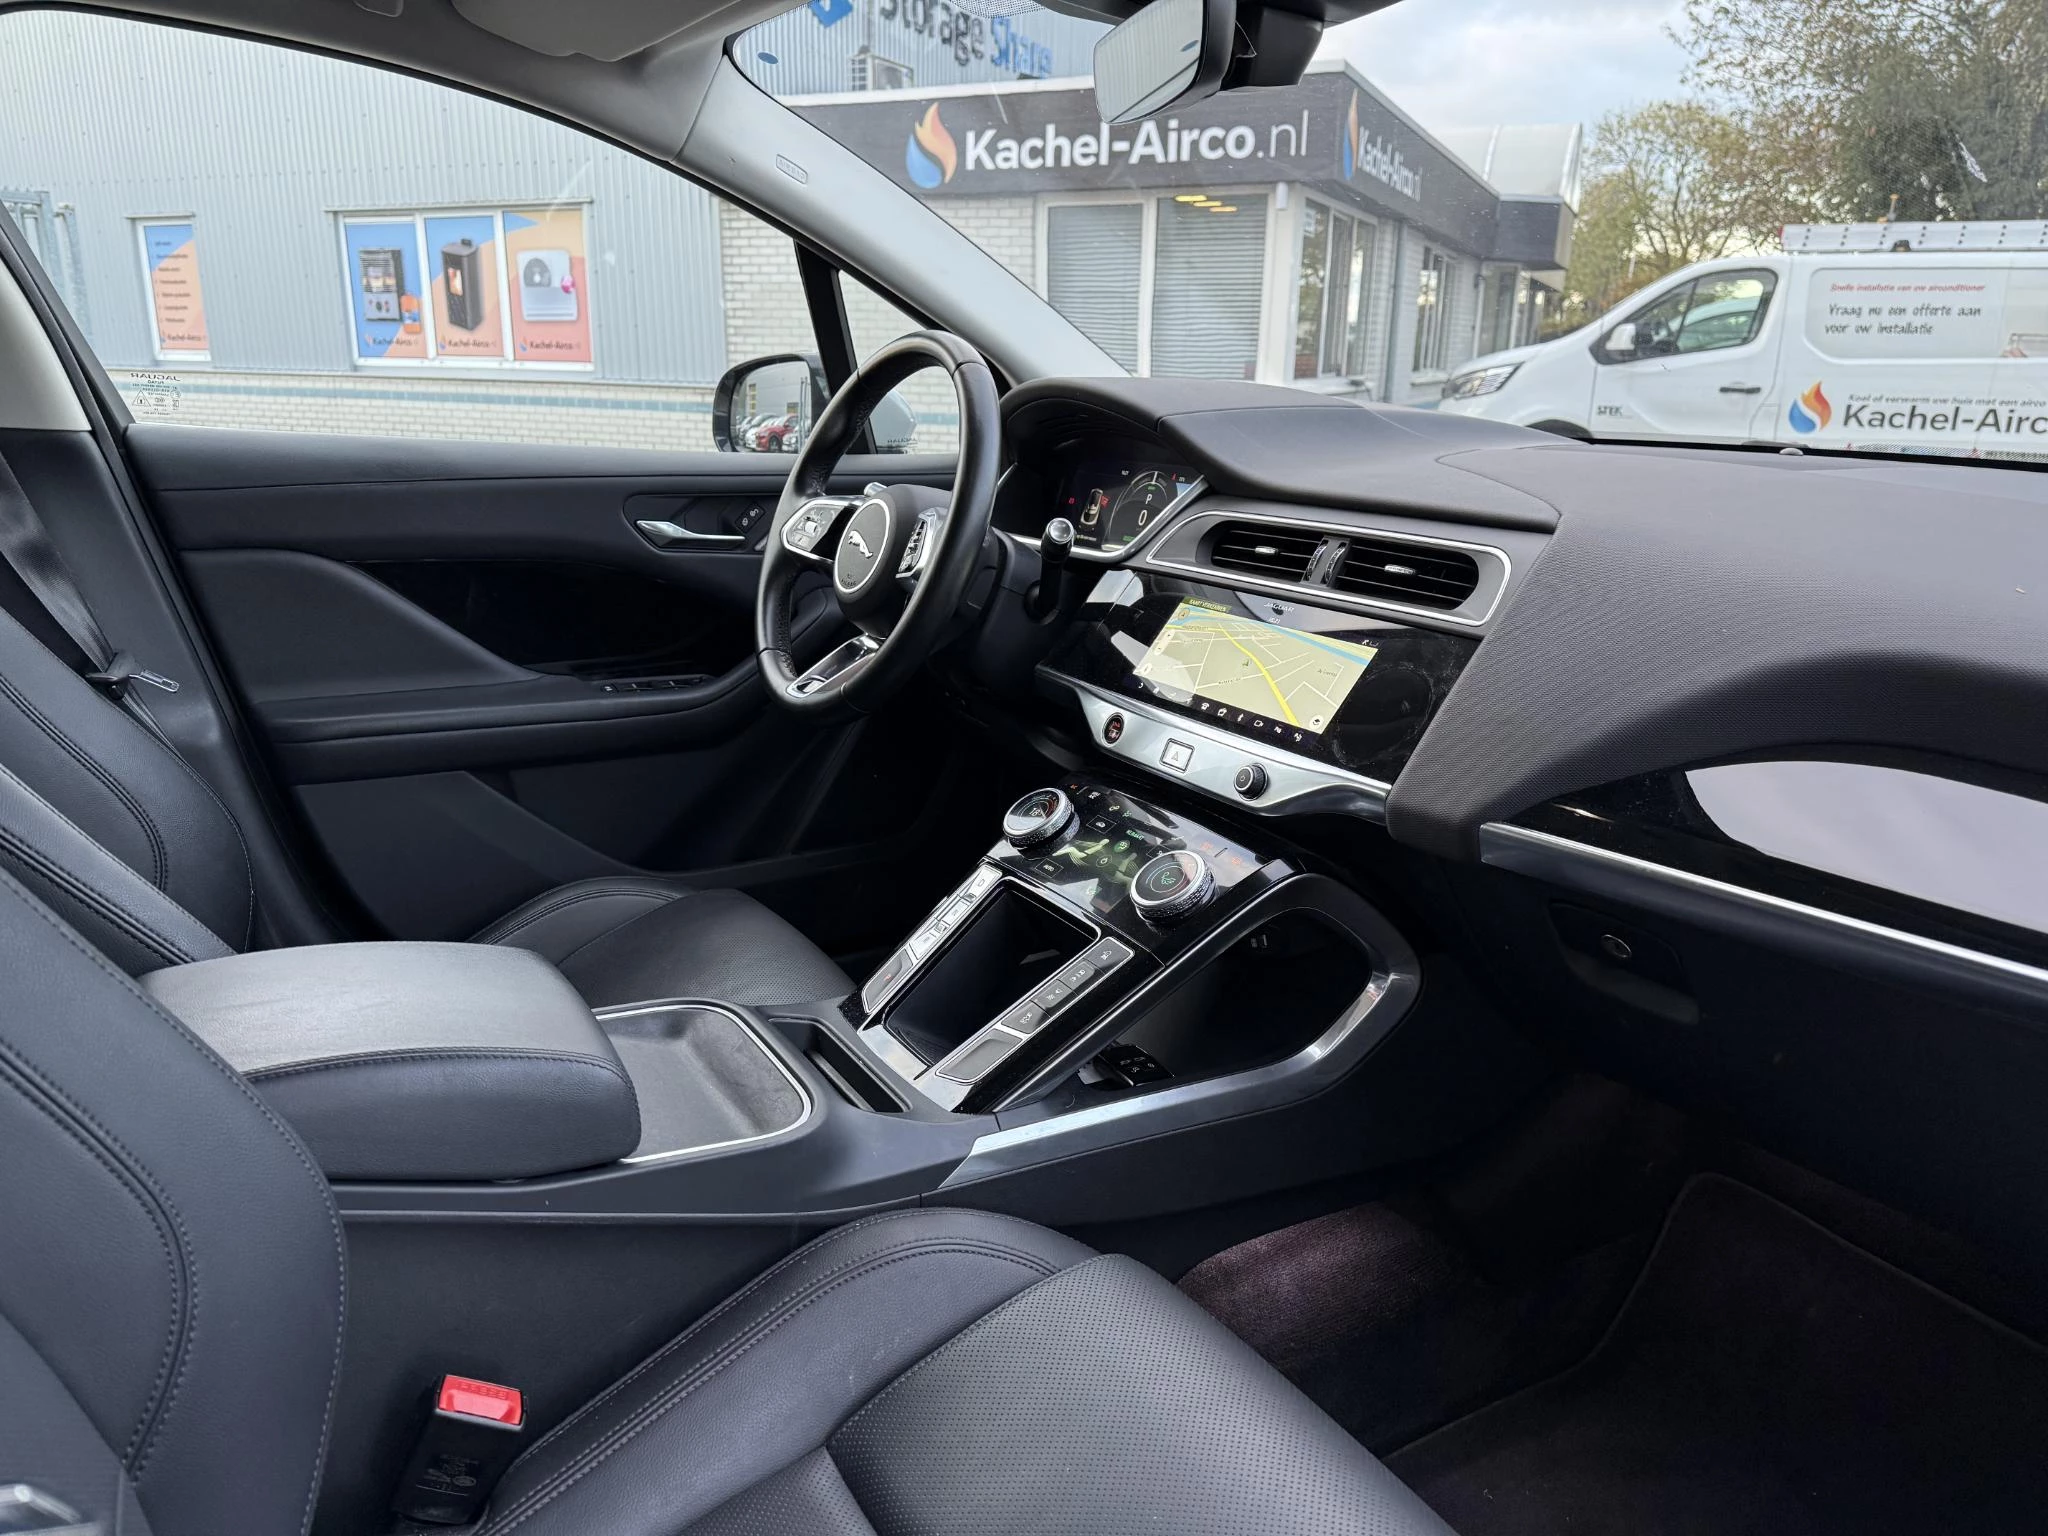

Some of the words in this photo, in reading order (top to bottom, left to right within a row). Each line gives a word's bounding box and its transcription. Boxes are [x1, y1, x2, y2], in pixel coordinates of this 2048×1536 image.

[965, 108, 1309, 171] Kachel-Airco.nl
[1829, 303, 1862, 318] Vraag
[1912, 303, 1952, 317] offerte
[1957, 307, 1982, 316] aan
[1825, 323, 1849, 335] voor
[1877, 321, 1934, 335] installatie
[1843, 403, 2048, 434] Kachel-Airc
[1263, 602, 1295, 613] JAGUAR
